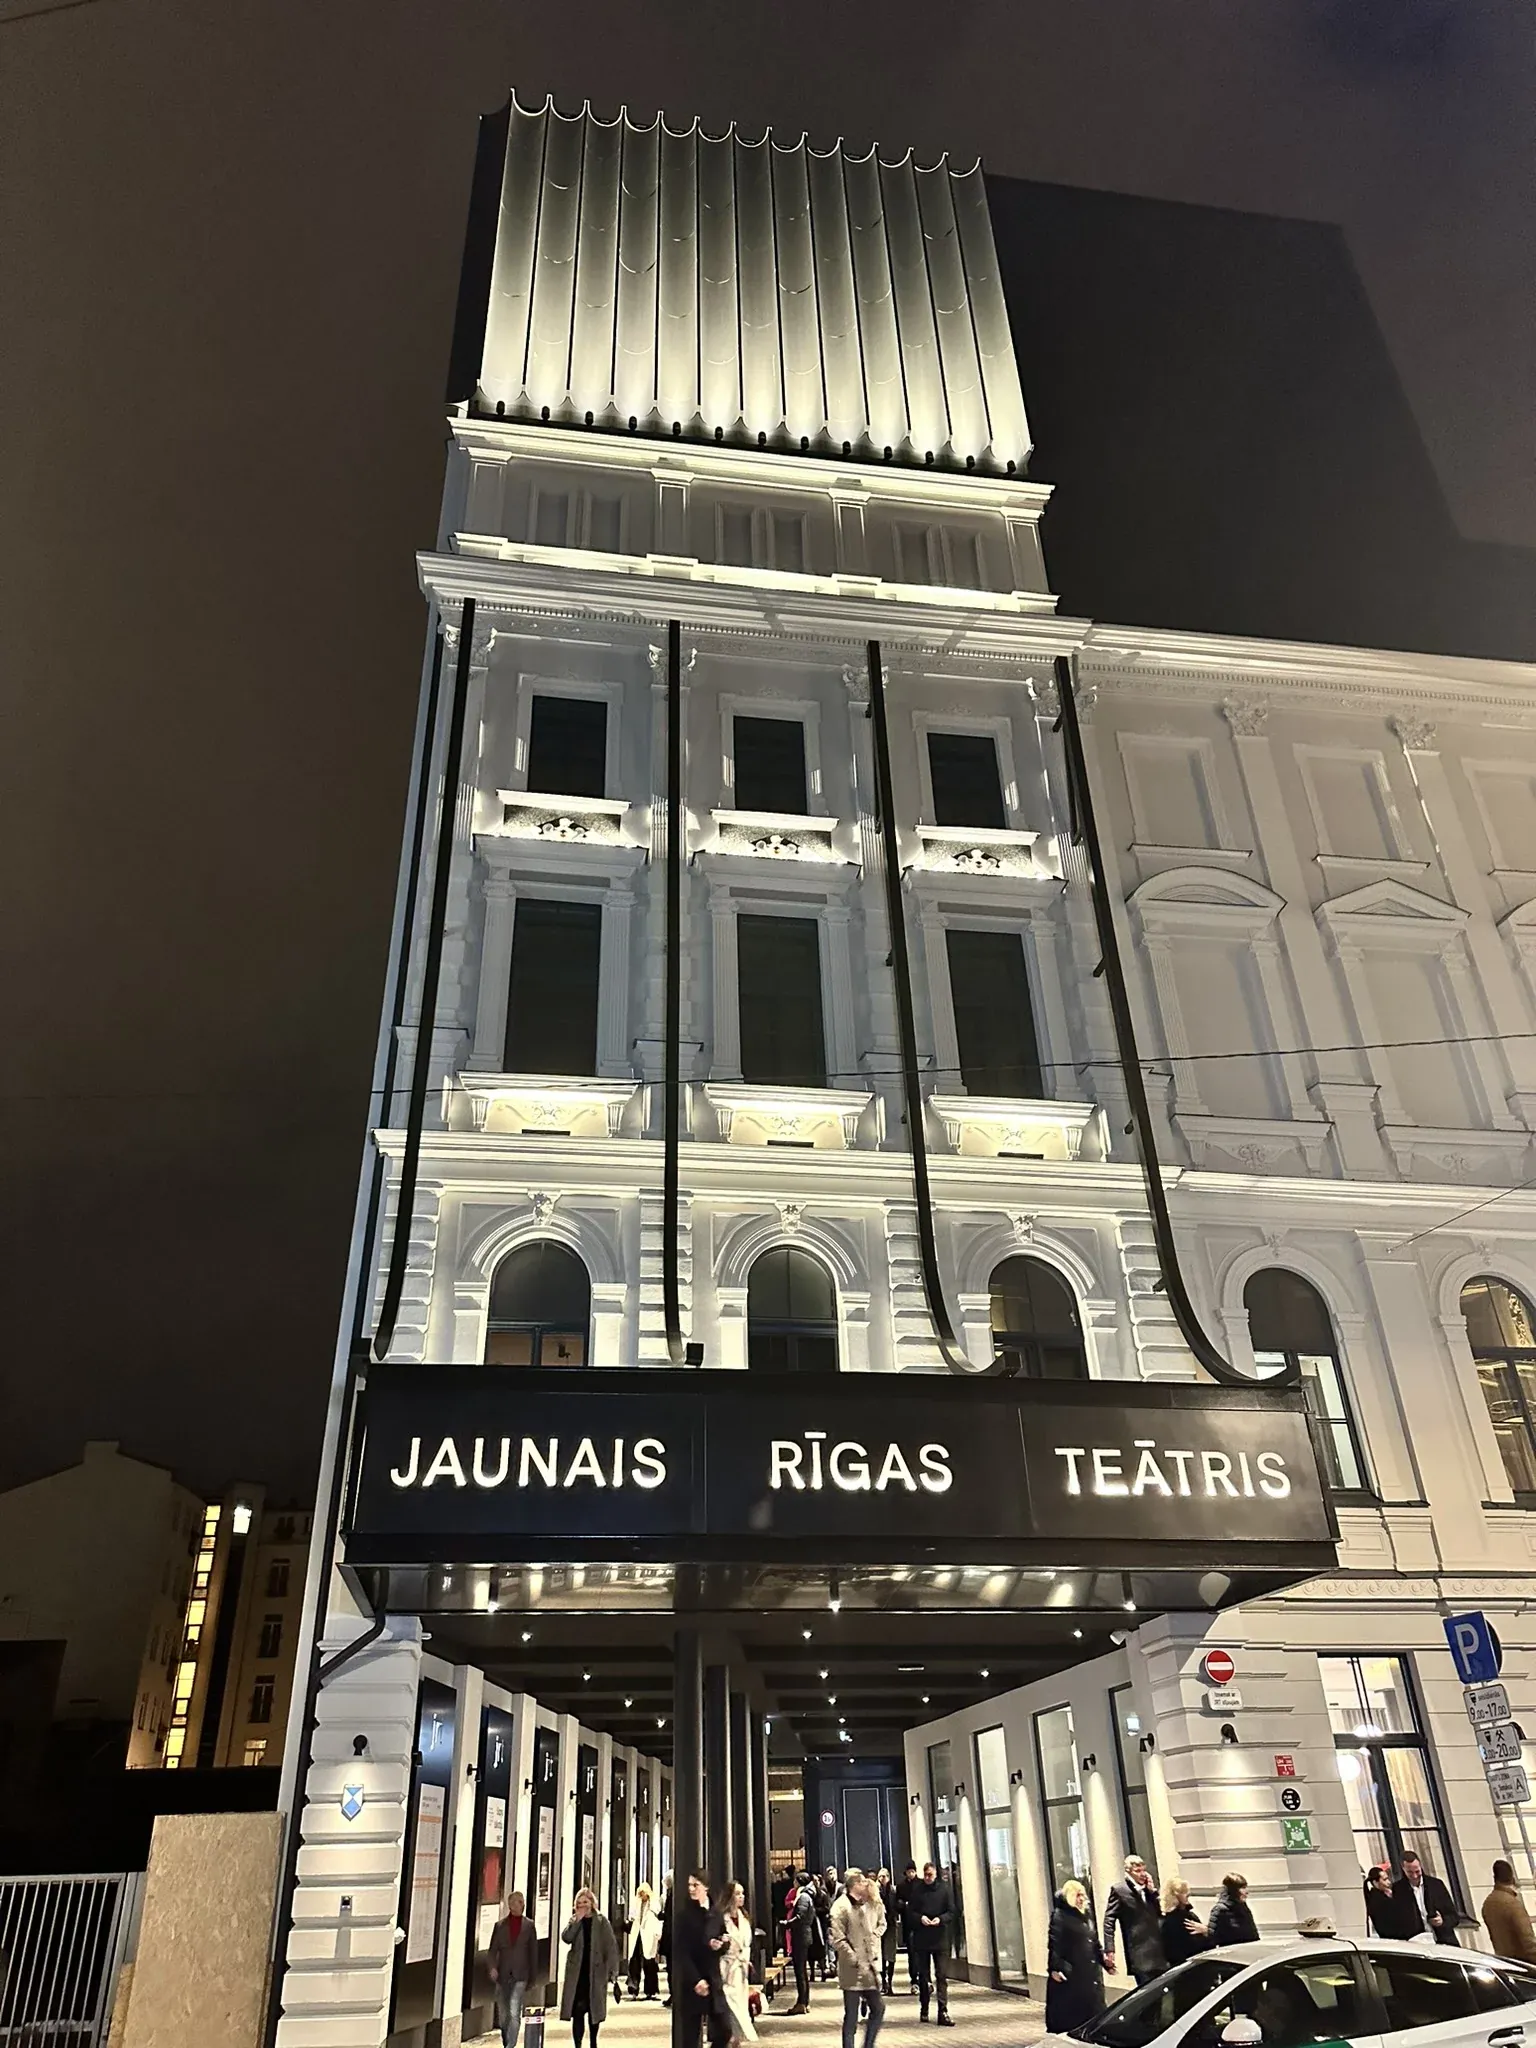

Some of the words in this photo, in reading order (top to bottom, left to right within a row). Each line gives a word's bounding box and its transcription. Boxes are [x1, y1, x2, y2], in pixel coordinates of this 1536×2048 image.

[390, 1435, 669, 1490] JAUNAIS
[769, 1431, 954, 1493] RĪGAS
[1054, 1440, 1293, 1500] TEĀTRIS
[1454, 1623, 1480, 1675] P
